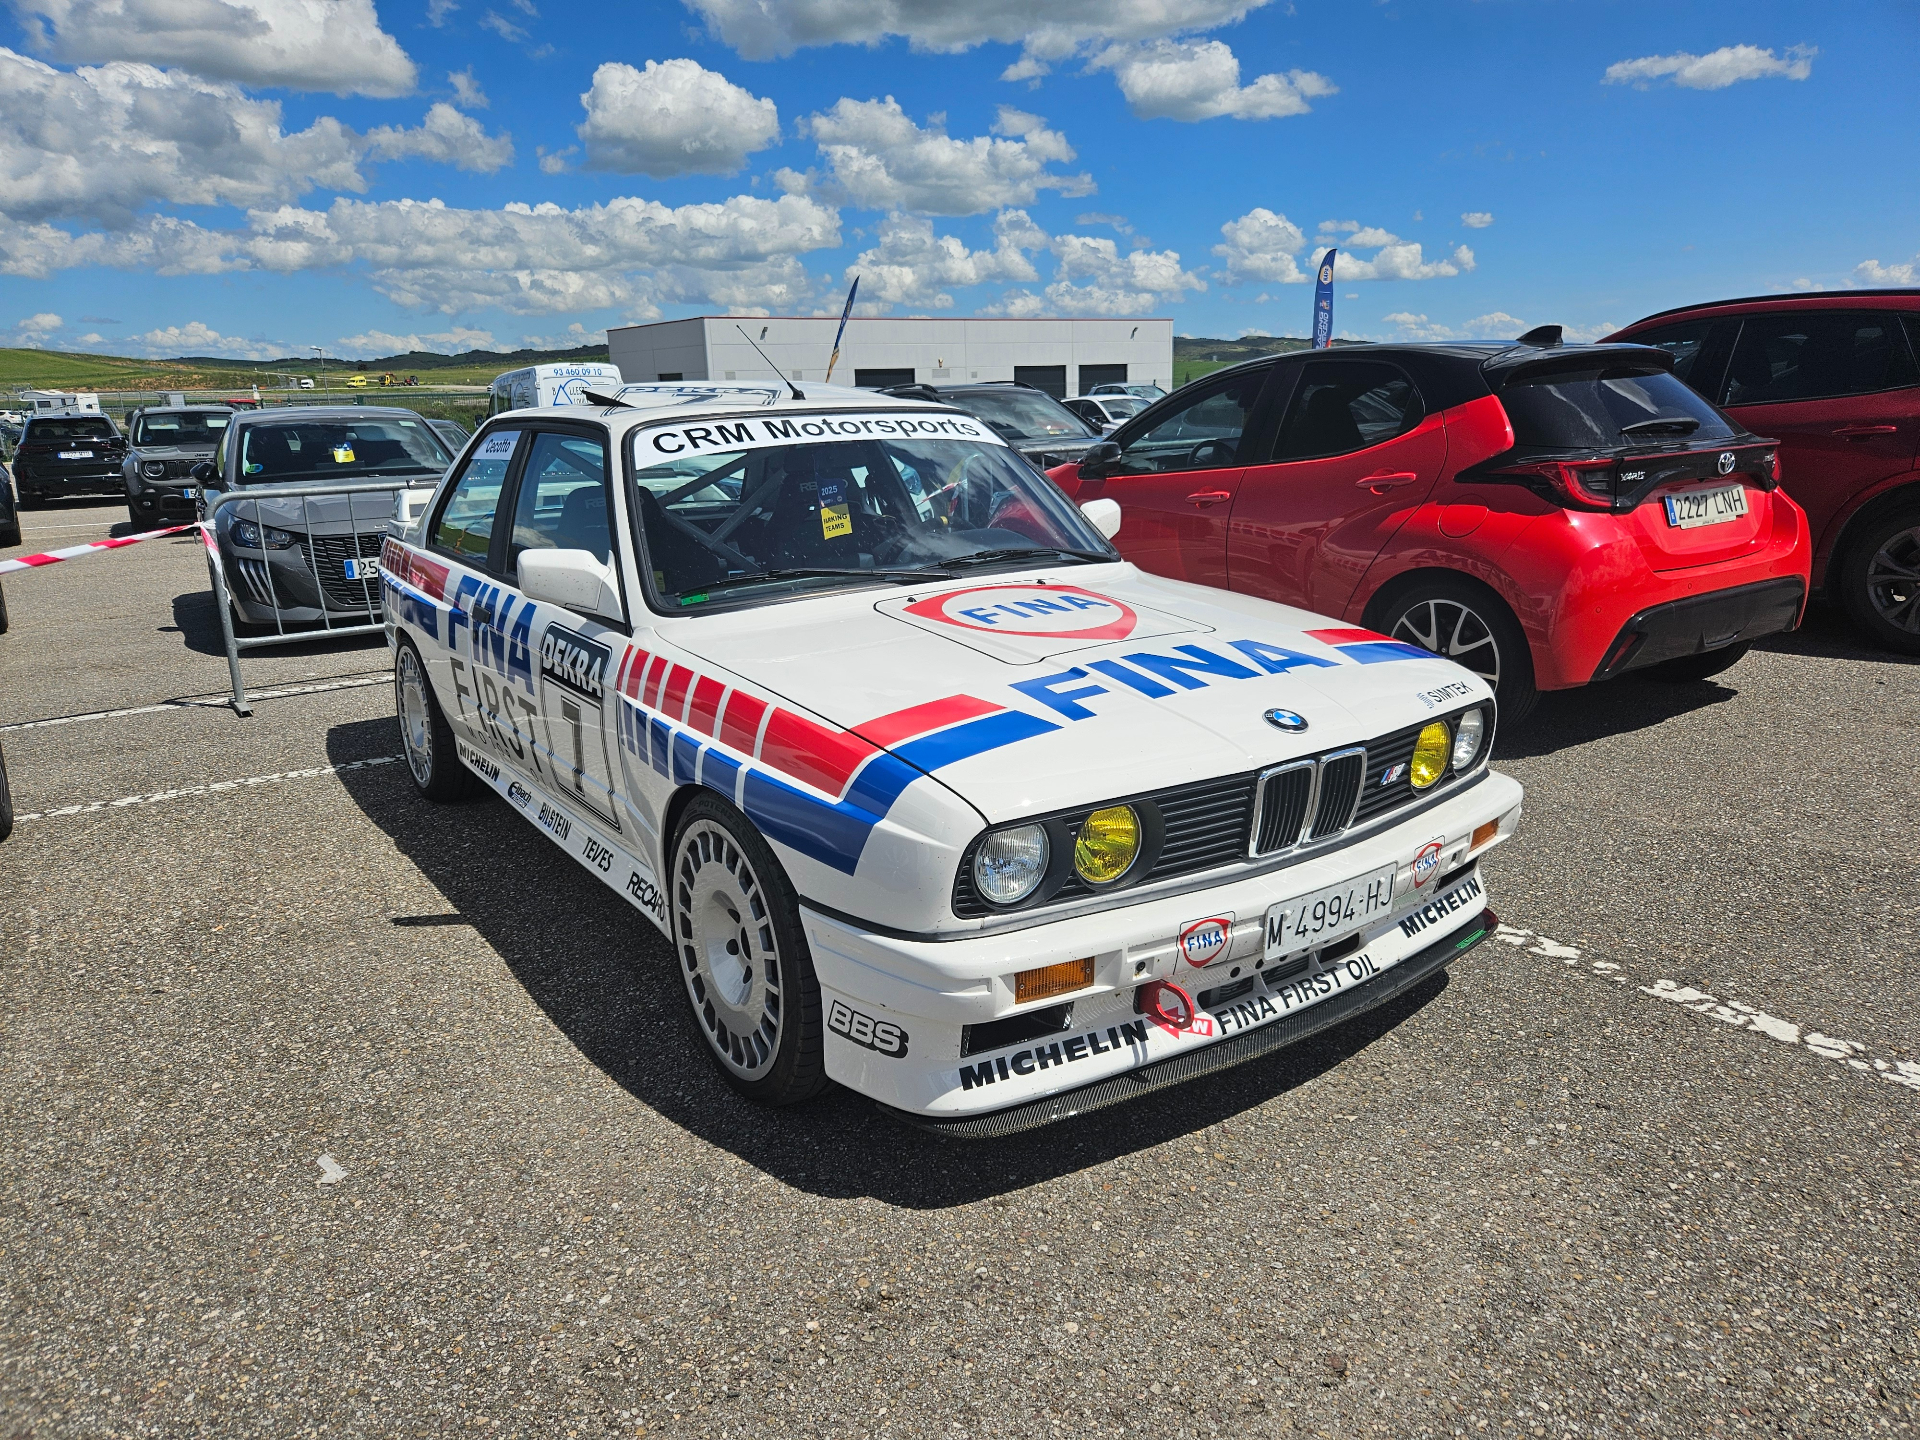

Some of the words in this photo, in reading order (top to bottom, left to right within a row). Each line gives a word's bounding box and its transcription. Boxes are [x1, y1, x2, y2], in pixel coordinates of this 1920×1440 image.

[565, 368, 580, 376] 460
[582, 368, 591, 376] 09
[627, 387, 775, 396] DEKRA
[652, 422, 757, 454] CRM
[761, 417, 982, 441] Motorsports
[821, 485, 838, 496] 2025
[1675, 494, 1708, 521] 2227
[1713, 489, 1744, 515] LNH
[825, 522, 845, 532] TEAMS
[957, 595, 1112, 625] FINA
[449, 575, 538, 697] FINA
[541, 633, 604, 698] DEKRA
[1008, 639, 1343, 722] FINA
[450, 656, 543, 774] FIRST
[459, 742, 501, 783] MICHELIN
[508, 781, 532, 803] Eibach
[538, 802, 572, 841] BILSTEIN
[582, 836, 614, 872] TEVES
[1416, 853, 1437, 873] FINA
[1266, 873, 1394, 950] M-4994-HJ
[1398, 877, 1482, 938] MICHELIN
[1187, 930, 1223, 952] FINA
[1213, 995, 1278, 1036] FINA
[1276, 966, 1344, 1009] FIRST
[1345, 954, 1380, 981] OIL
[829, 999, 909, 1059] BBS
[959, 1020, 1149, 1091] MICHELIN
